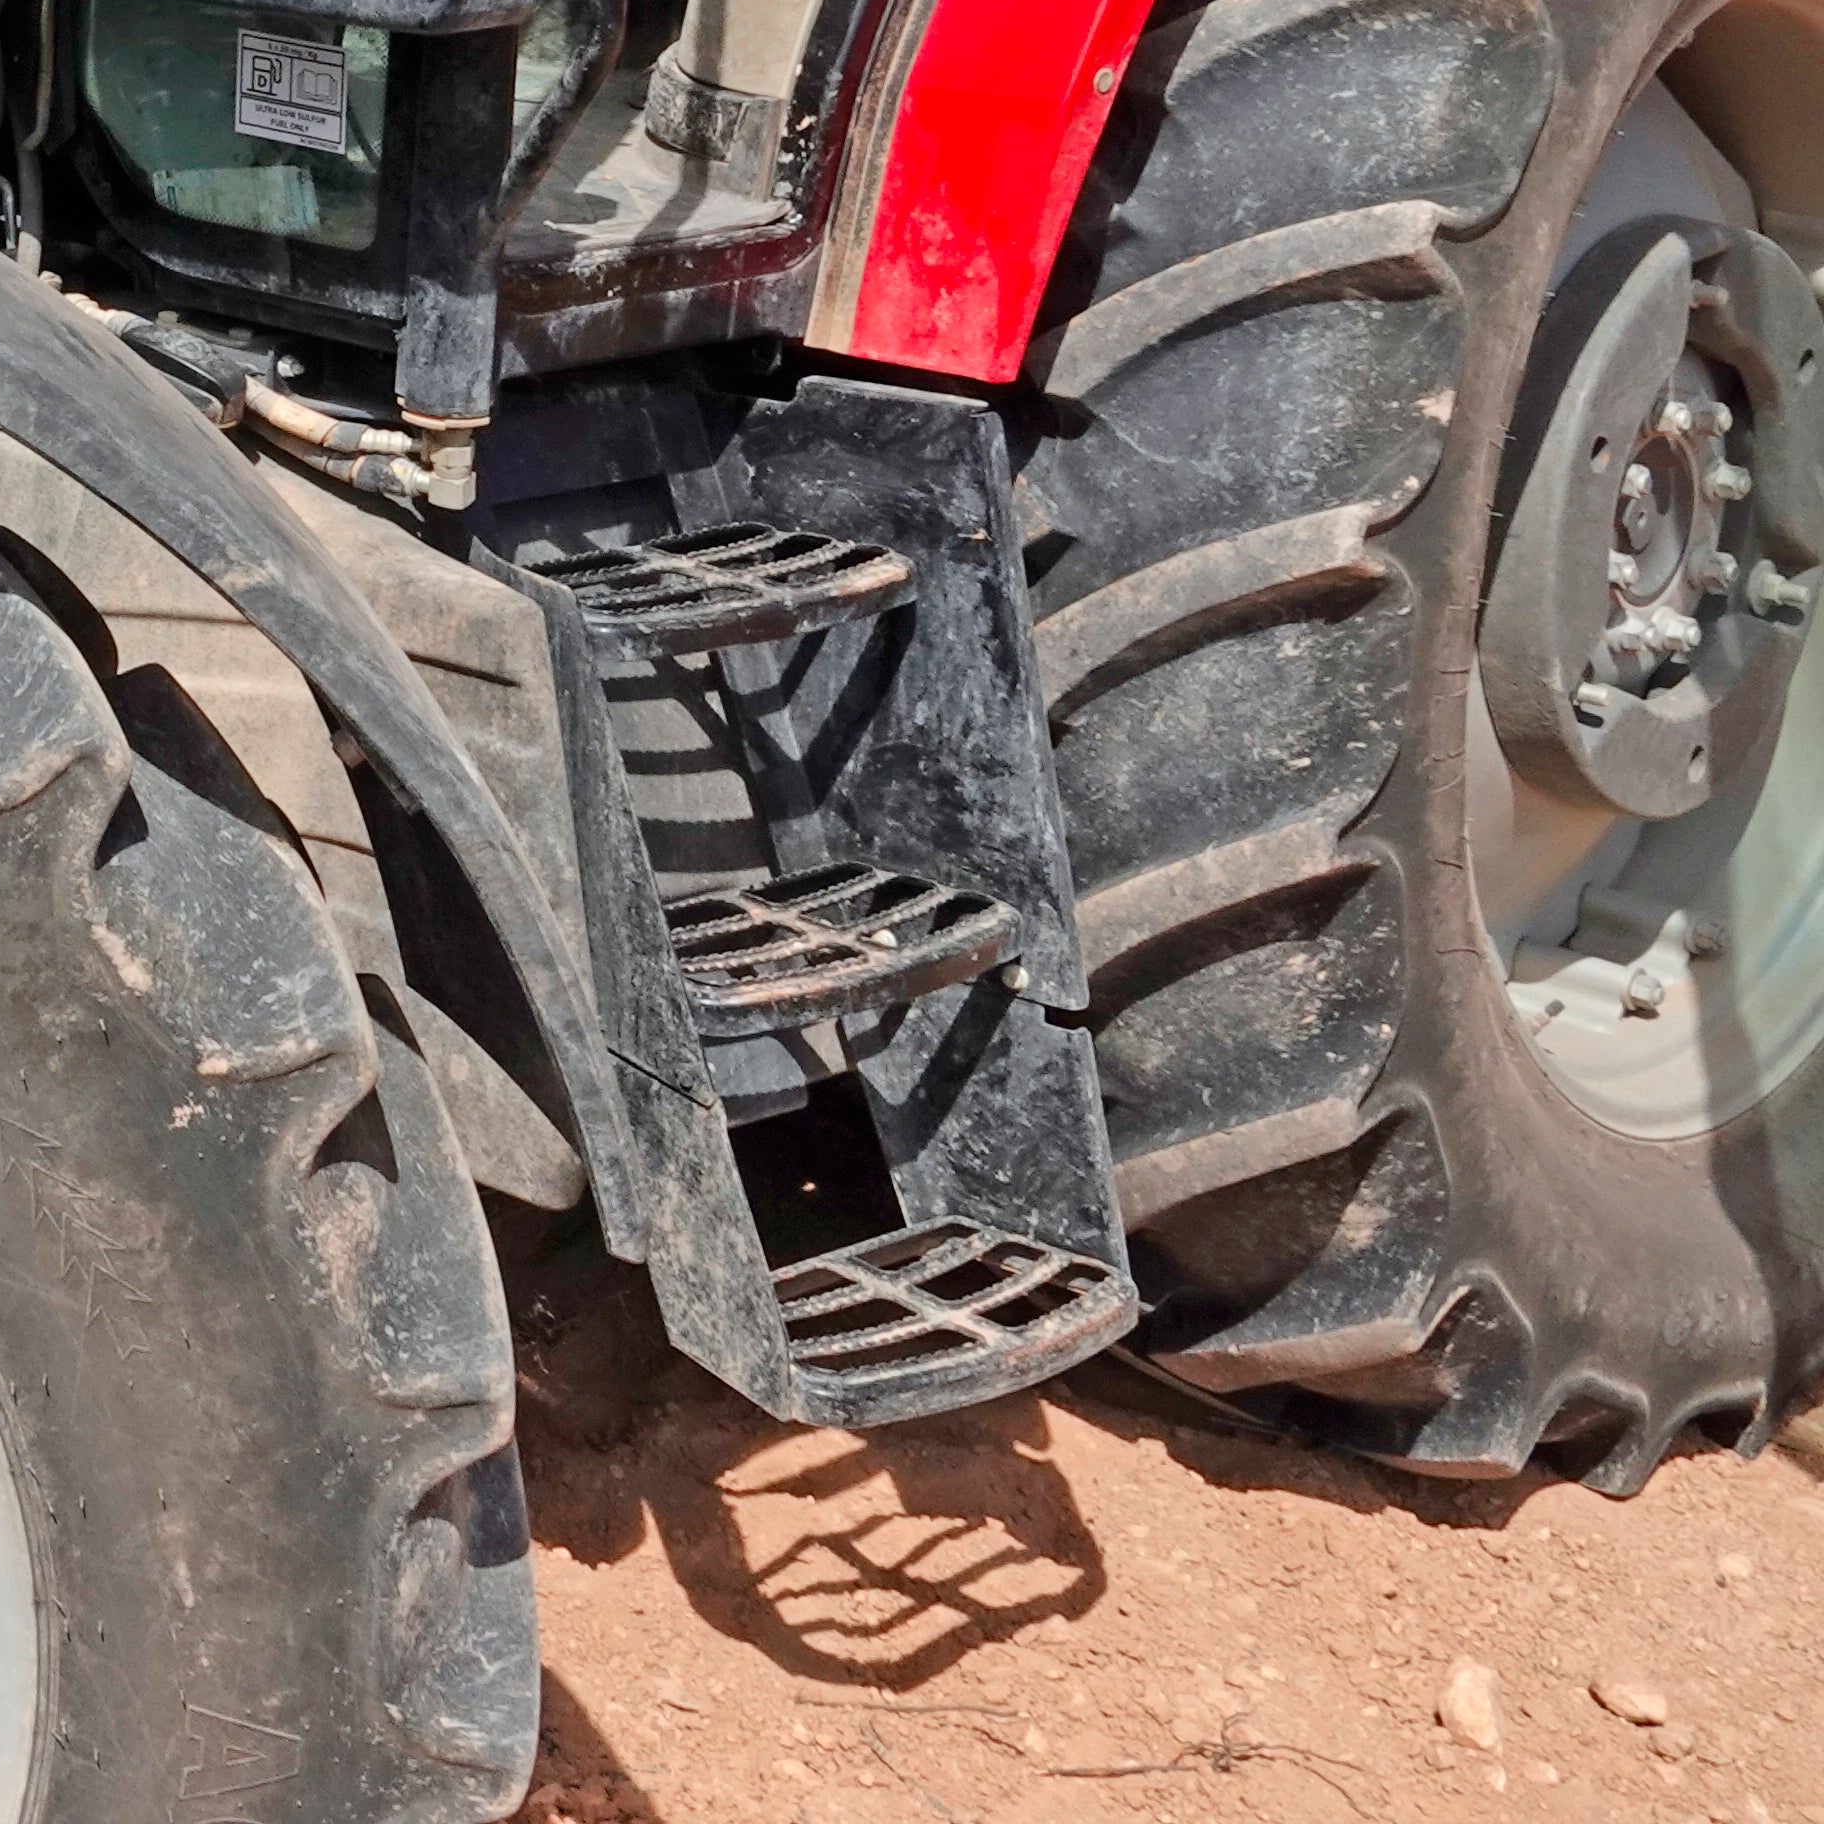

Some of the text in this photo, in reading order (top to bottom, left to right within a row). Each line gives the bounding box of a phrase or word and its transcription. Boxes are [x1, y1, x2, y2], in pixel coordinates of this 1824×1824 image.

[258, 74, 267, 87] D
[256, 104, 278, 116] ULTRA
[280, 109, 295, 118] LOW
[270, 118, 308, 132] FUEL ONLY
